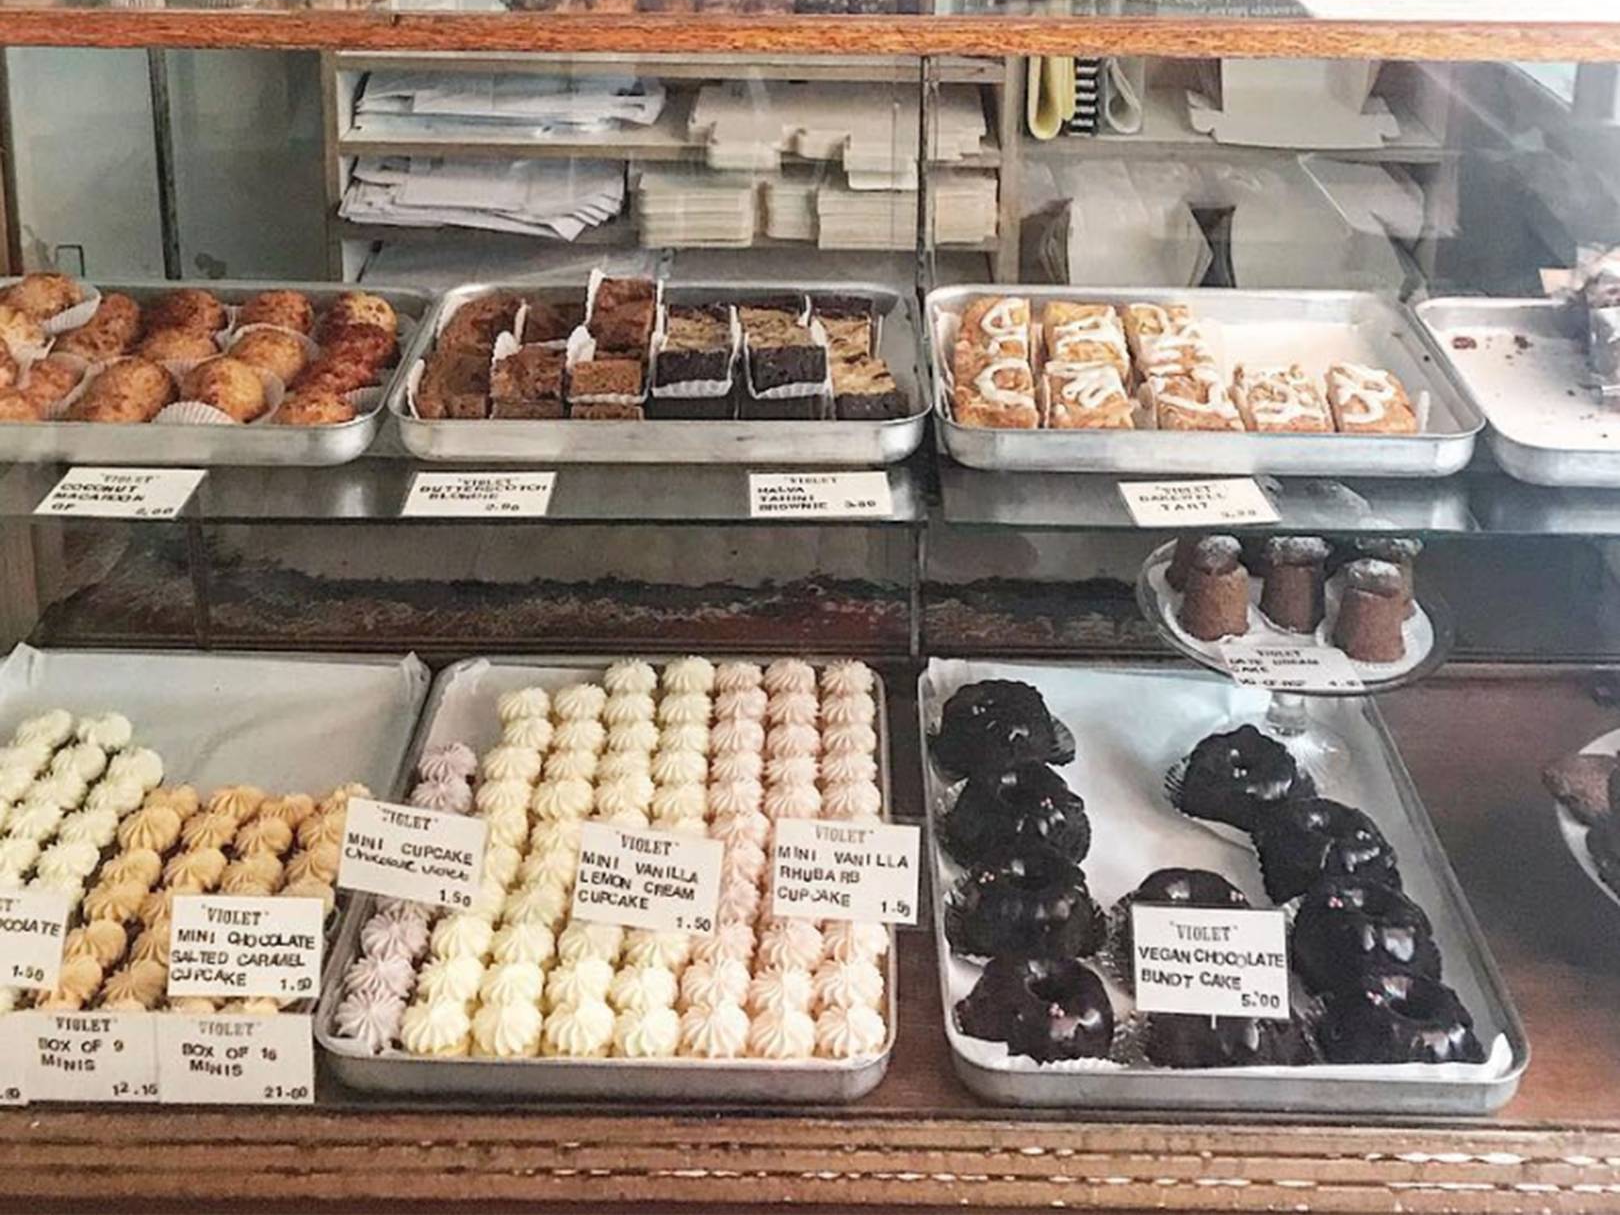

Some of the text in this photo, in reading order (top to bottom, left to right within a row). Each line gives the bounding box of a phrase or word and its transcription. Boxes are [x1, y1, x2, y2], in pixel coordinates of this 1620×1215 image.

[61, 484, 137, 493] COCONUT
[759, 503, 827, 511] BROWNIE
[1161, 502, 1207, 511] TART
[348, 833, 473, 866] MINI CUPCAKE
[778, 846, 909, 868] MINI VANILLA
[581, 851, 698, 883] MINI VANILLA
[780, 865, 860, 884] RHUBARB
[580, 870, 695, 900] LEMON CREAM
[440, 889, 471, 907] 1.50
[578, 890, 649, 909] CUPCAKE
[777, 886, 851, 908] CUPCAKE
[676, 917, 711, 932] 1.50
[177, 929, 315, 950] MINI CHOCOLATE
[172, 950, 305, 967] SALTED CARAMEL
[1138, 946, 1284, 968] VEGAN CHOCOLATE
[12, 965, 44, 981] 1.50
[171, 969, 246, 986] CUPCAKE
[1200, 971, 1241, 990] CAKE
[38, 1038, 70, 1052] BOX
[82, 1039, 102, 1052] OF
[182, 1043, 214, 1058] BOX
[226, 1046, 248, 1059] OF
[41, 1054, 95, 1072] MINIS
[189, 1059, 243, 1076] MINIS
